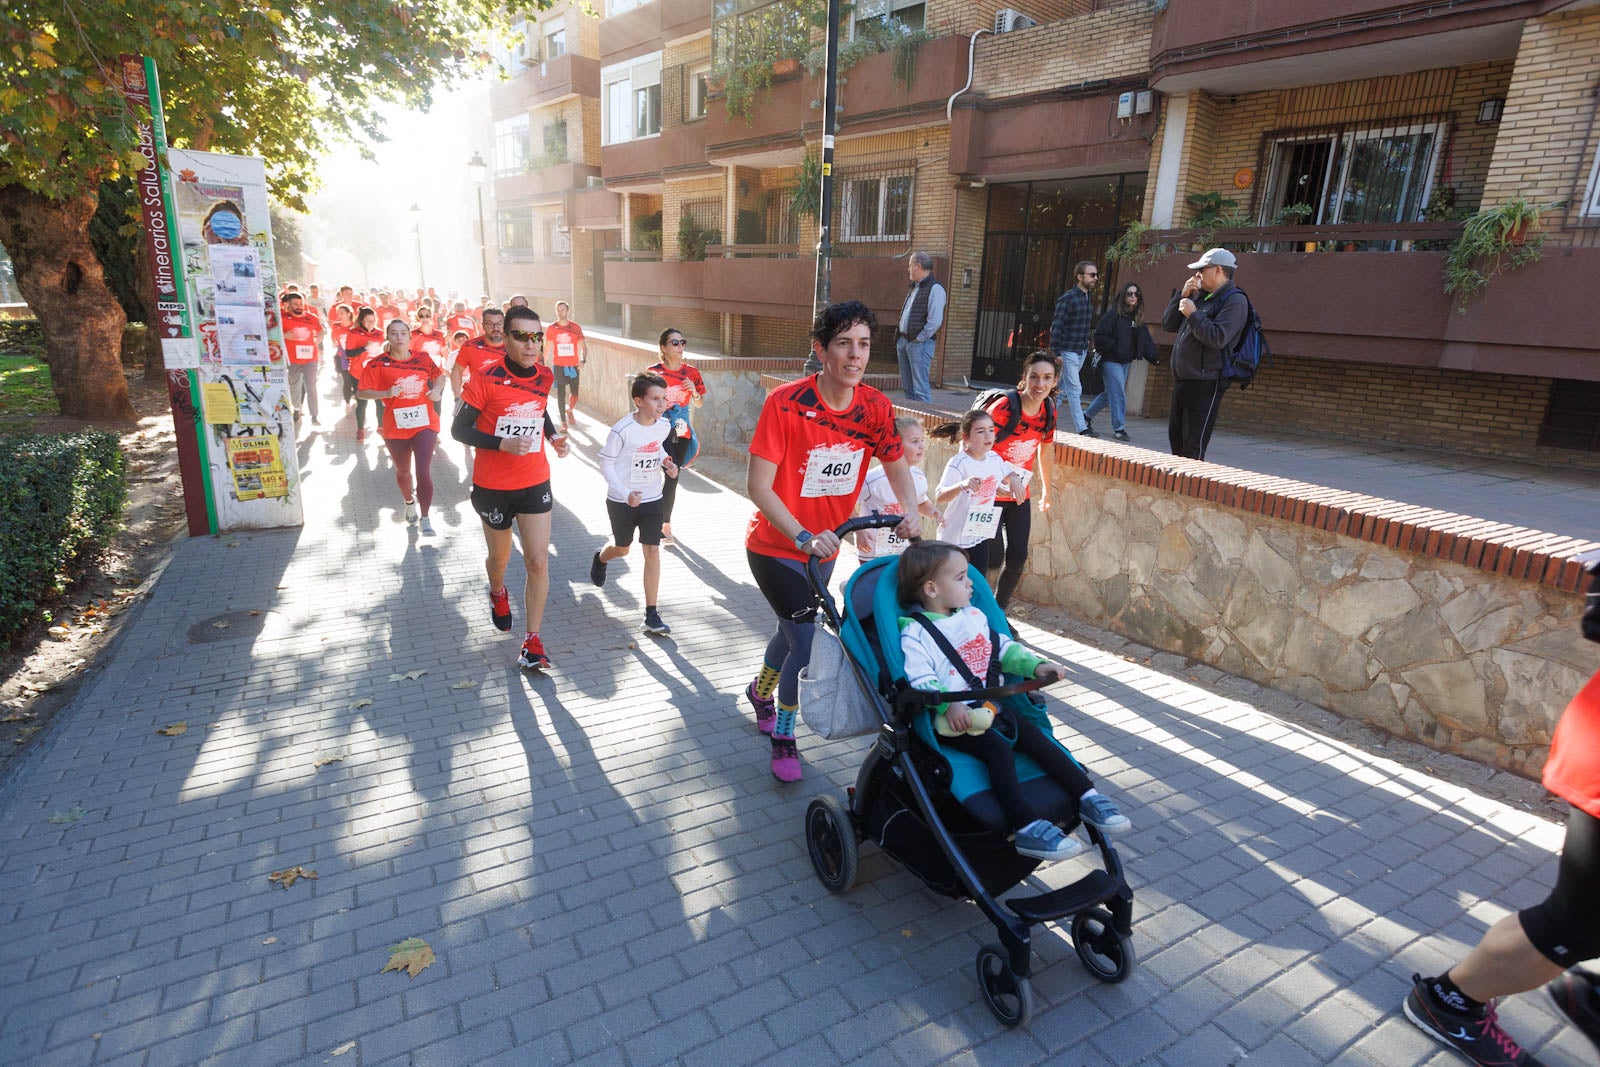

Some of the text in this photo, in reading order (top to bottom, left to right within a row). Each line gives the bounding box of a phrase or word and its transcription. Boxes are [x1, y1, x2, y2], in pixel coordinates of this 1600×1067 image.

[1066, 214, 1073, 227] 2
[402, 411, 420, 420] 312
[504, 424, 536, 437] 1277
[231, 440, 271, 449] MOLINA
[821, 462, 851, 477] 460
[262, 475, 276, 484] 149
[969, 511, 994, 523] 1165
